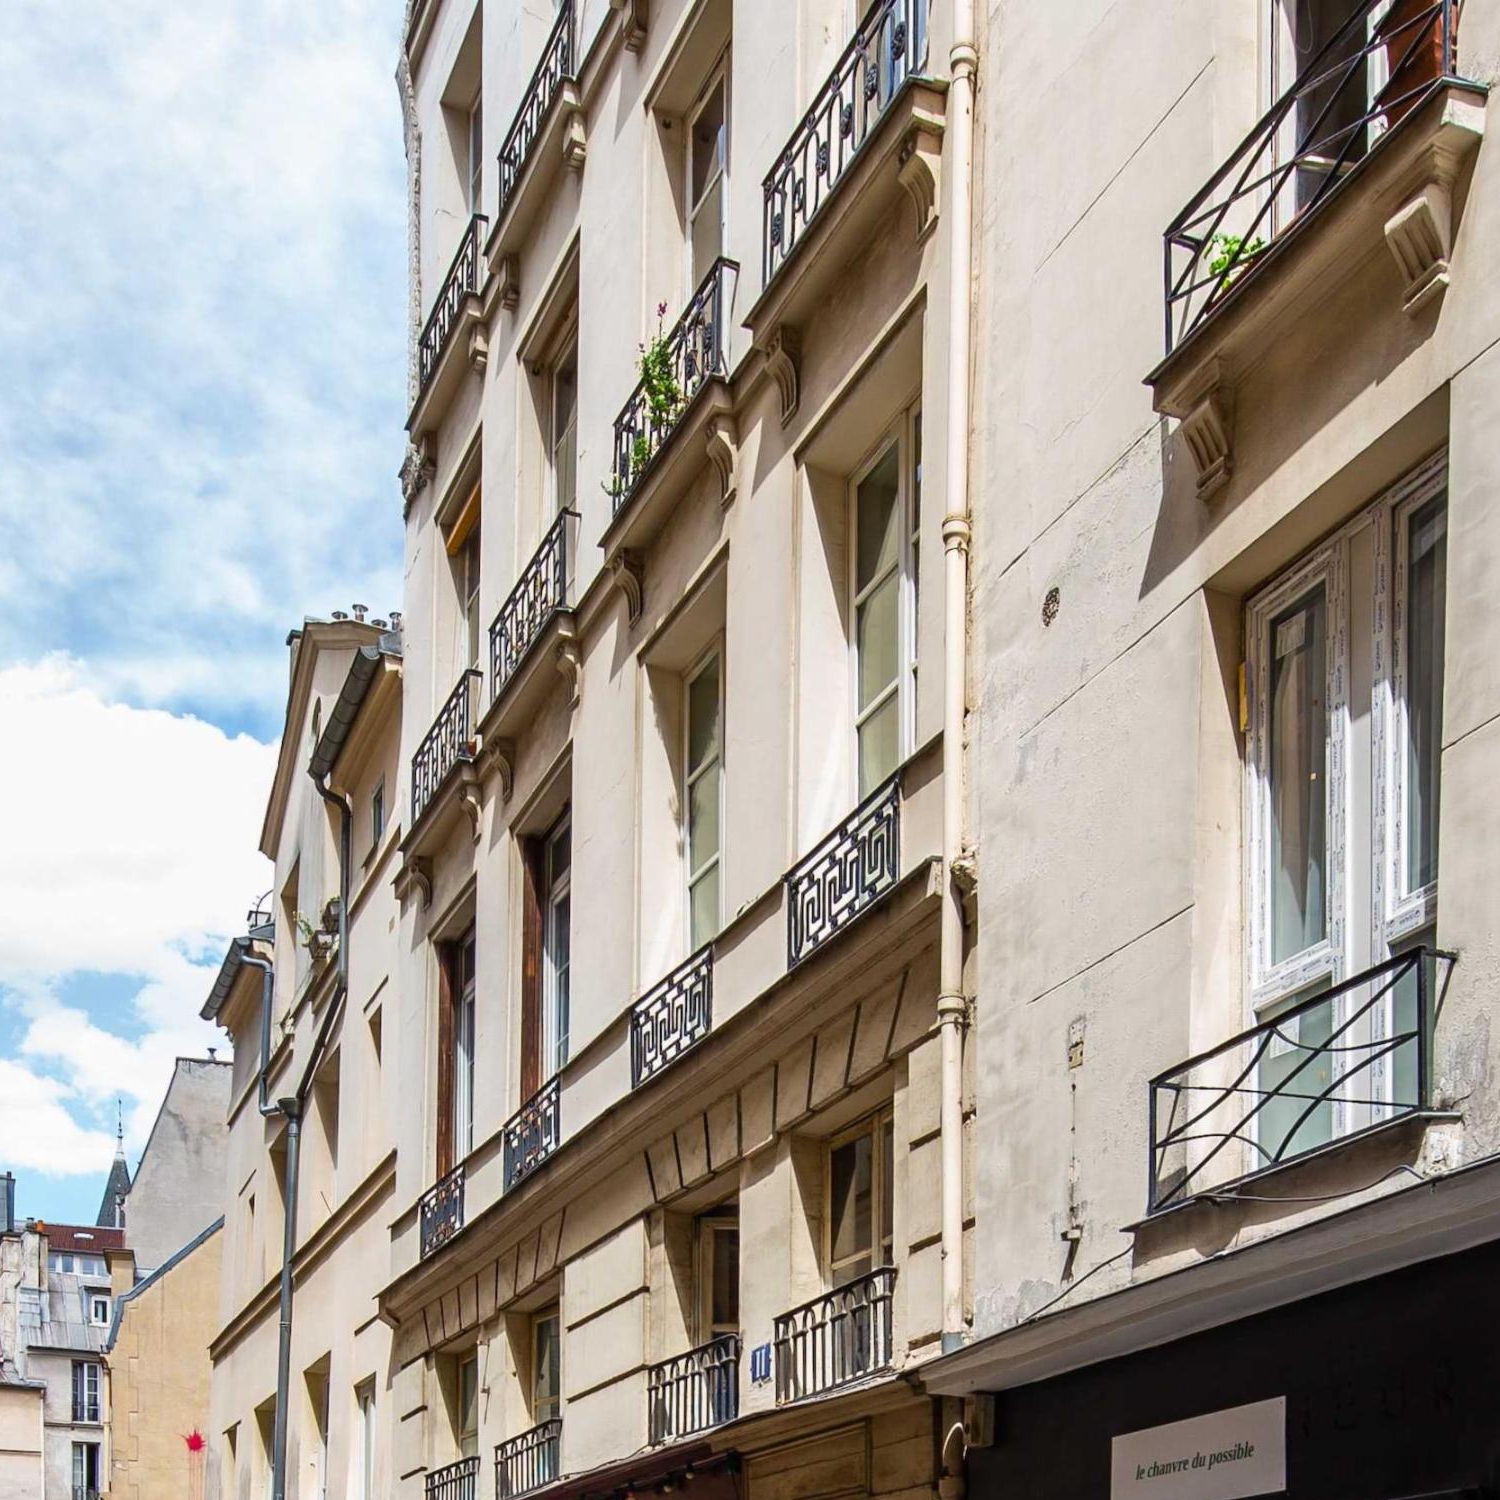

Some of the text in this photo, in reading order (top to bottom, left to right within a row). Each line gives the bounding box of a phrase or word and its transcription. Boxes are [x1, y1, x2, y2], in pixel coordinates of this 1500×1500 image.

[1135, 1441, 1255, 1481] le chanvre du possible
